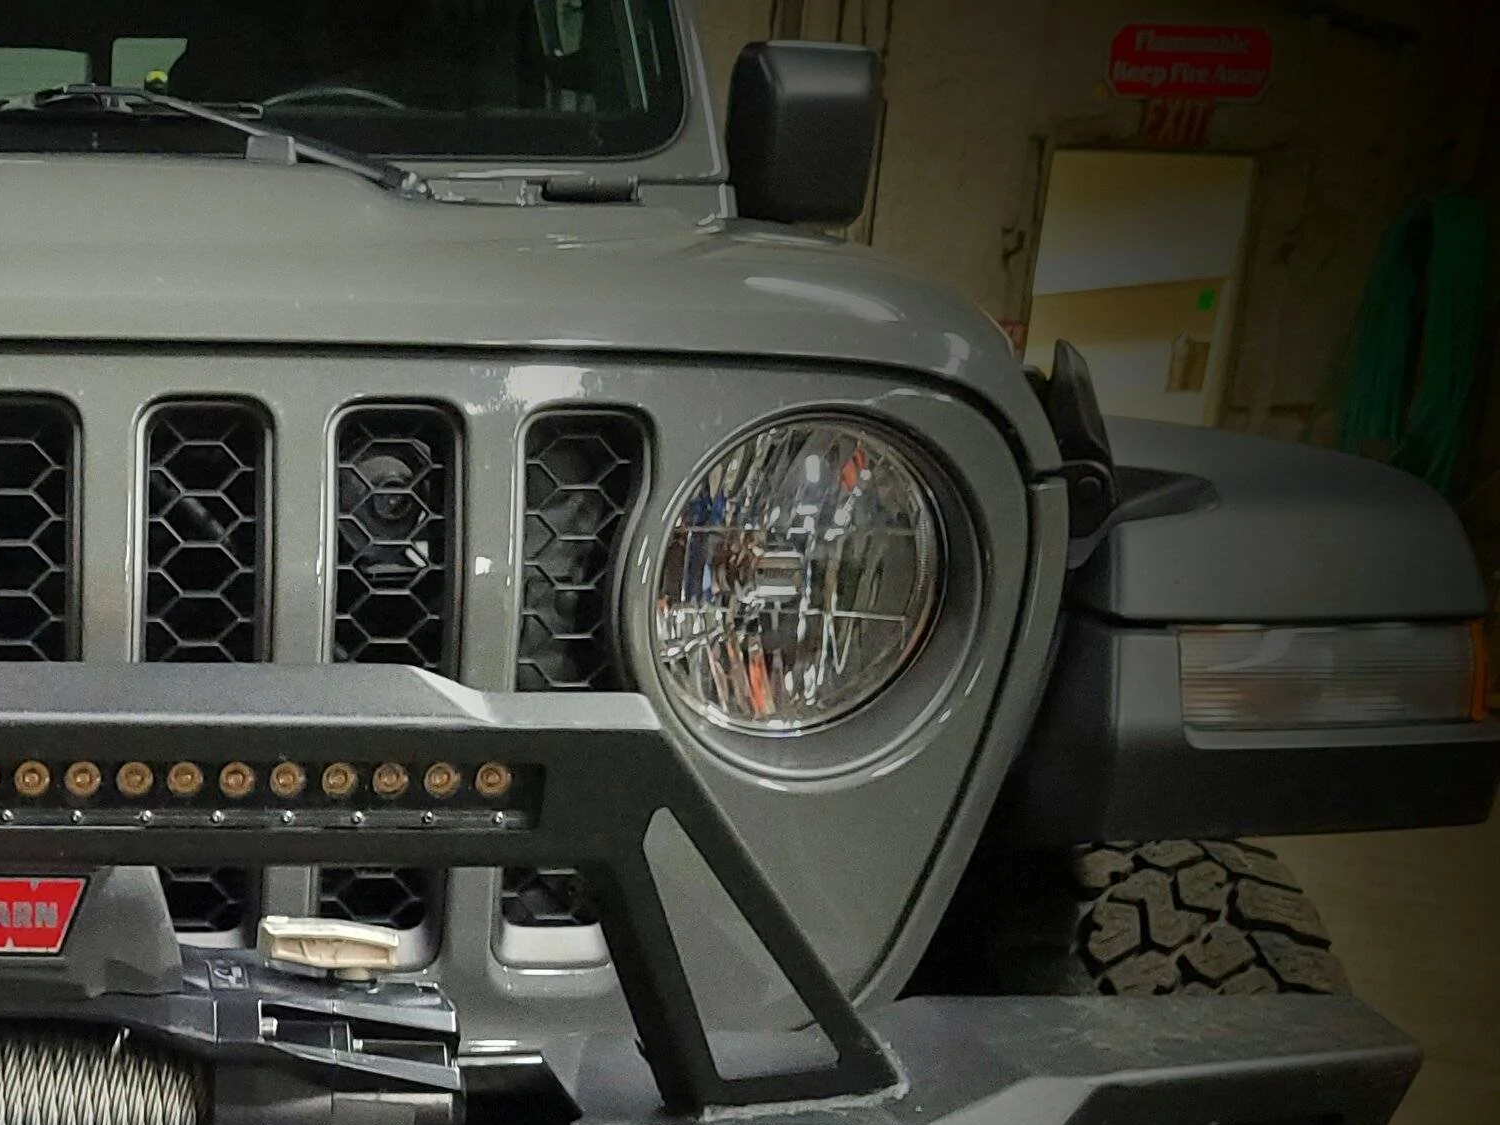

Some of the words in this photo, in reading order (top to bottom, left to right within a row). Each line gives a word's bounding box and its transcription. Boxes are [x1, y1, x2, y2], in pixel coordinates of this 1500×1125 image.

[1112, 60, 1167, 87] Keep
[1169, 61, 1210, 84] Fire
[1212, 63, 1268, 88] Away
[1144, 97, 1211, 147] EXIT
